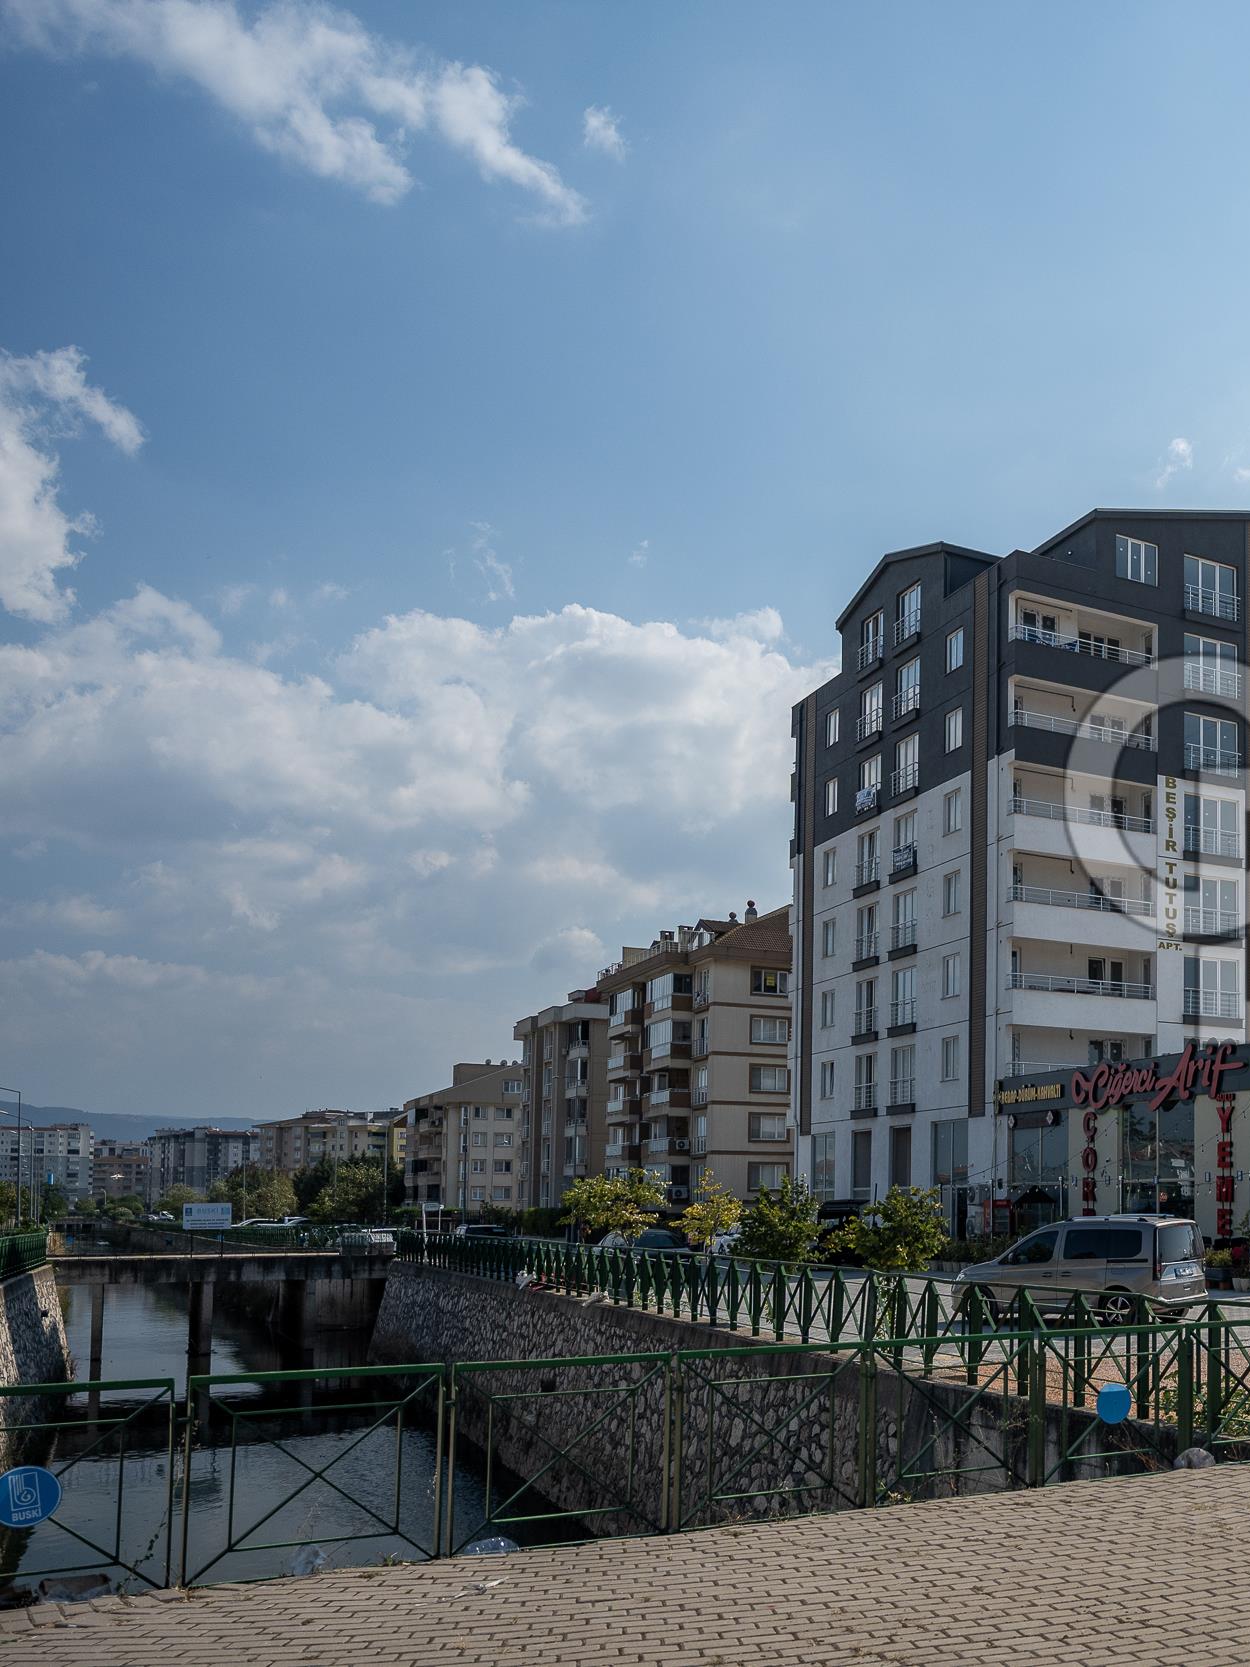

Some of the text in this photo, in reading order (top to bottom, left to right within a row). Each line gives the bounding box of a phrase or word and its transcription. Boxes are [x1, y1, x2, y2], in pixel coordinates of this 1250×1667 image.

[1165, 776, 1178, 853] BEŞİR
[1165, 862, 1178, 938] TUTUŞ
[1158, 941, 1182, 951] APT.
[1151, 1043, 1244, 1112] Arif
